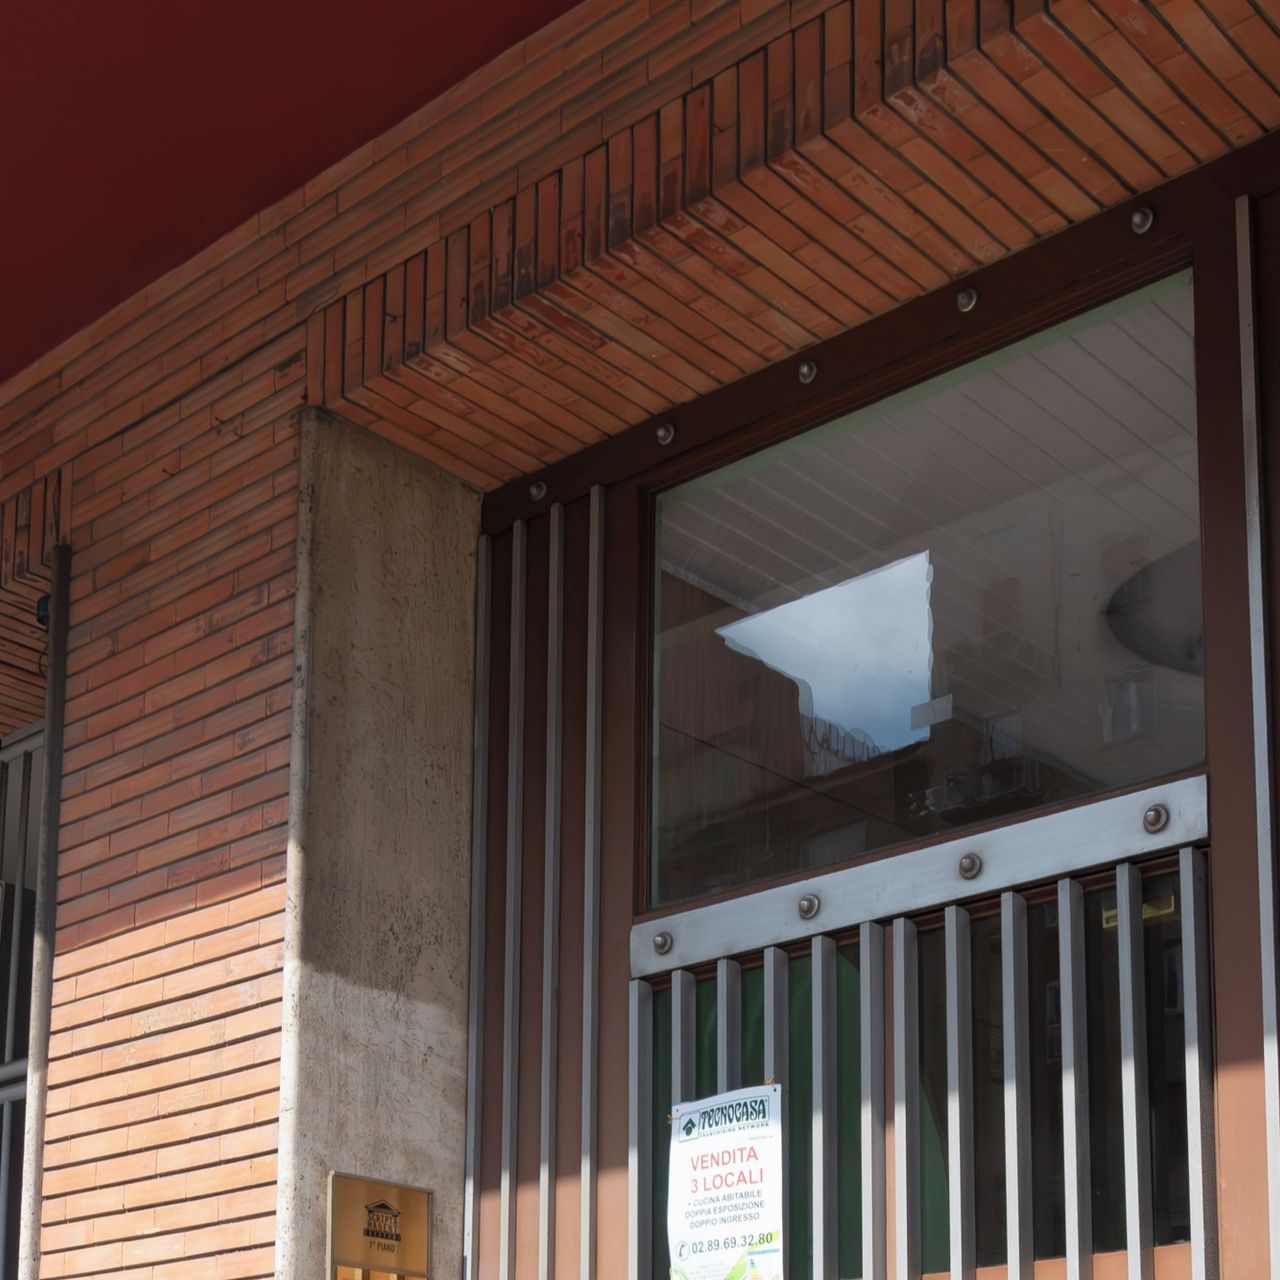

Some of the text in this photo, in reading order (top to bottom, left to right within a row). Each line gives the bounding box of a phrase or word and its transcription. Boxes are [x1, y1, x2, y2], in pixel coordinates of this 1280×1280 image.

[700, 1098, 767, 1130] TECNOCASA
[699, 1127, 736, 1138] FRANCHISING
[738, 1122, 770, 1132] NETWORK
[690, 1145, 759, 1172] VENDITA
[691, 1167, 764, 1194] 3 LOCALI
[693, 1194, 721, 1207] CUCINA
[721, 1189, 763, 1202] ABITABILE
[684, 1199, 765, 1219] DOPPIA ESPOSIZIONE
[689, 1212, 761, 1230] DOPPIO INGRESSO
[691, 1231, 774, 1254] 02.89.69.32.80
